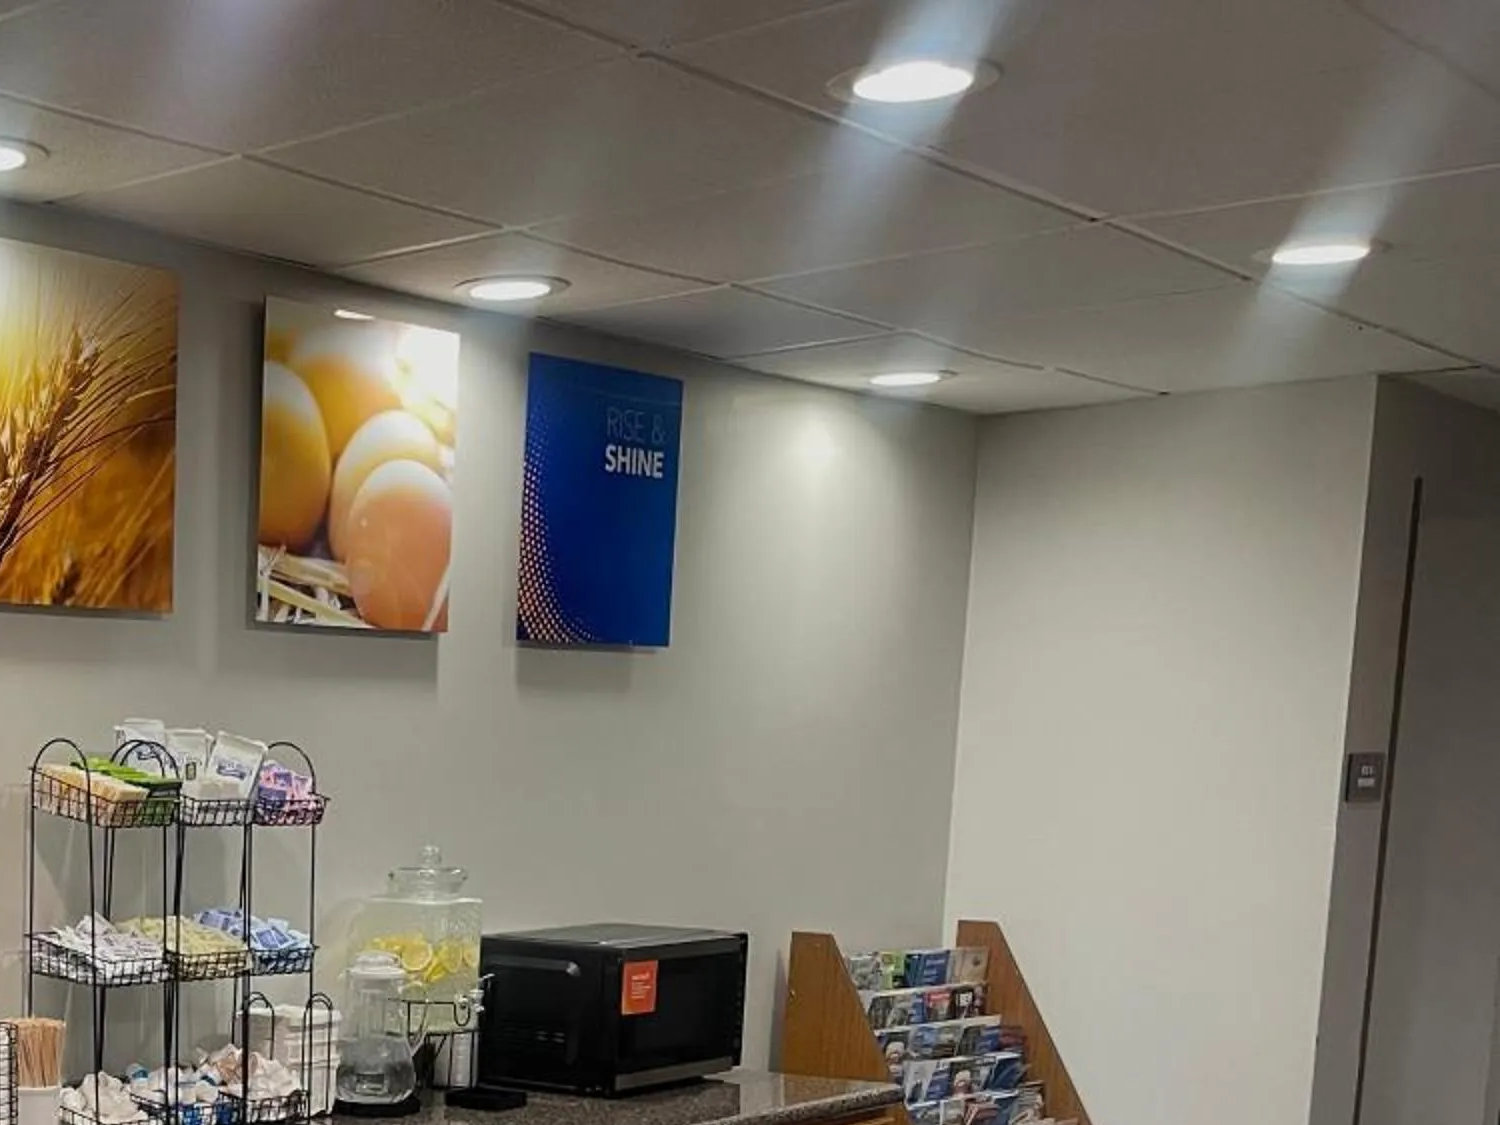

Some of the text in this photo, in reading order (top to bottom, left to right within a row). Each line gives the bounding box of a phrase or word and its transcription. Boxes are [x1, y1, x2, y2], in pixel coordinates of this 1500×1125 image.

[606, 406, 668, 445] RISE &
[605, 444, 665, 478] SHINE
